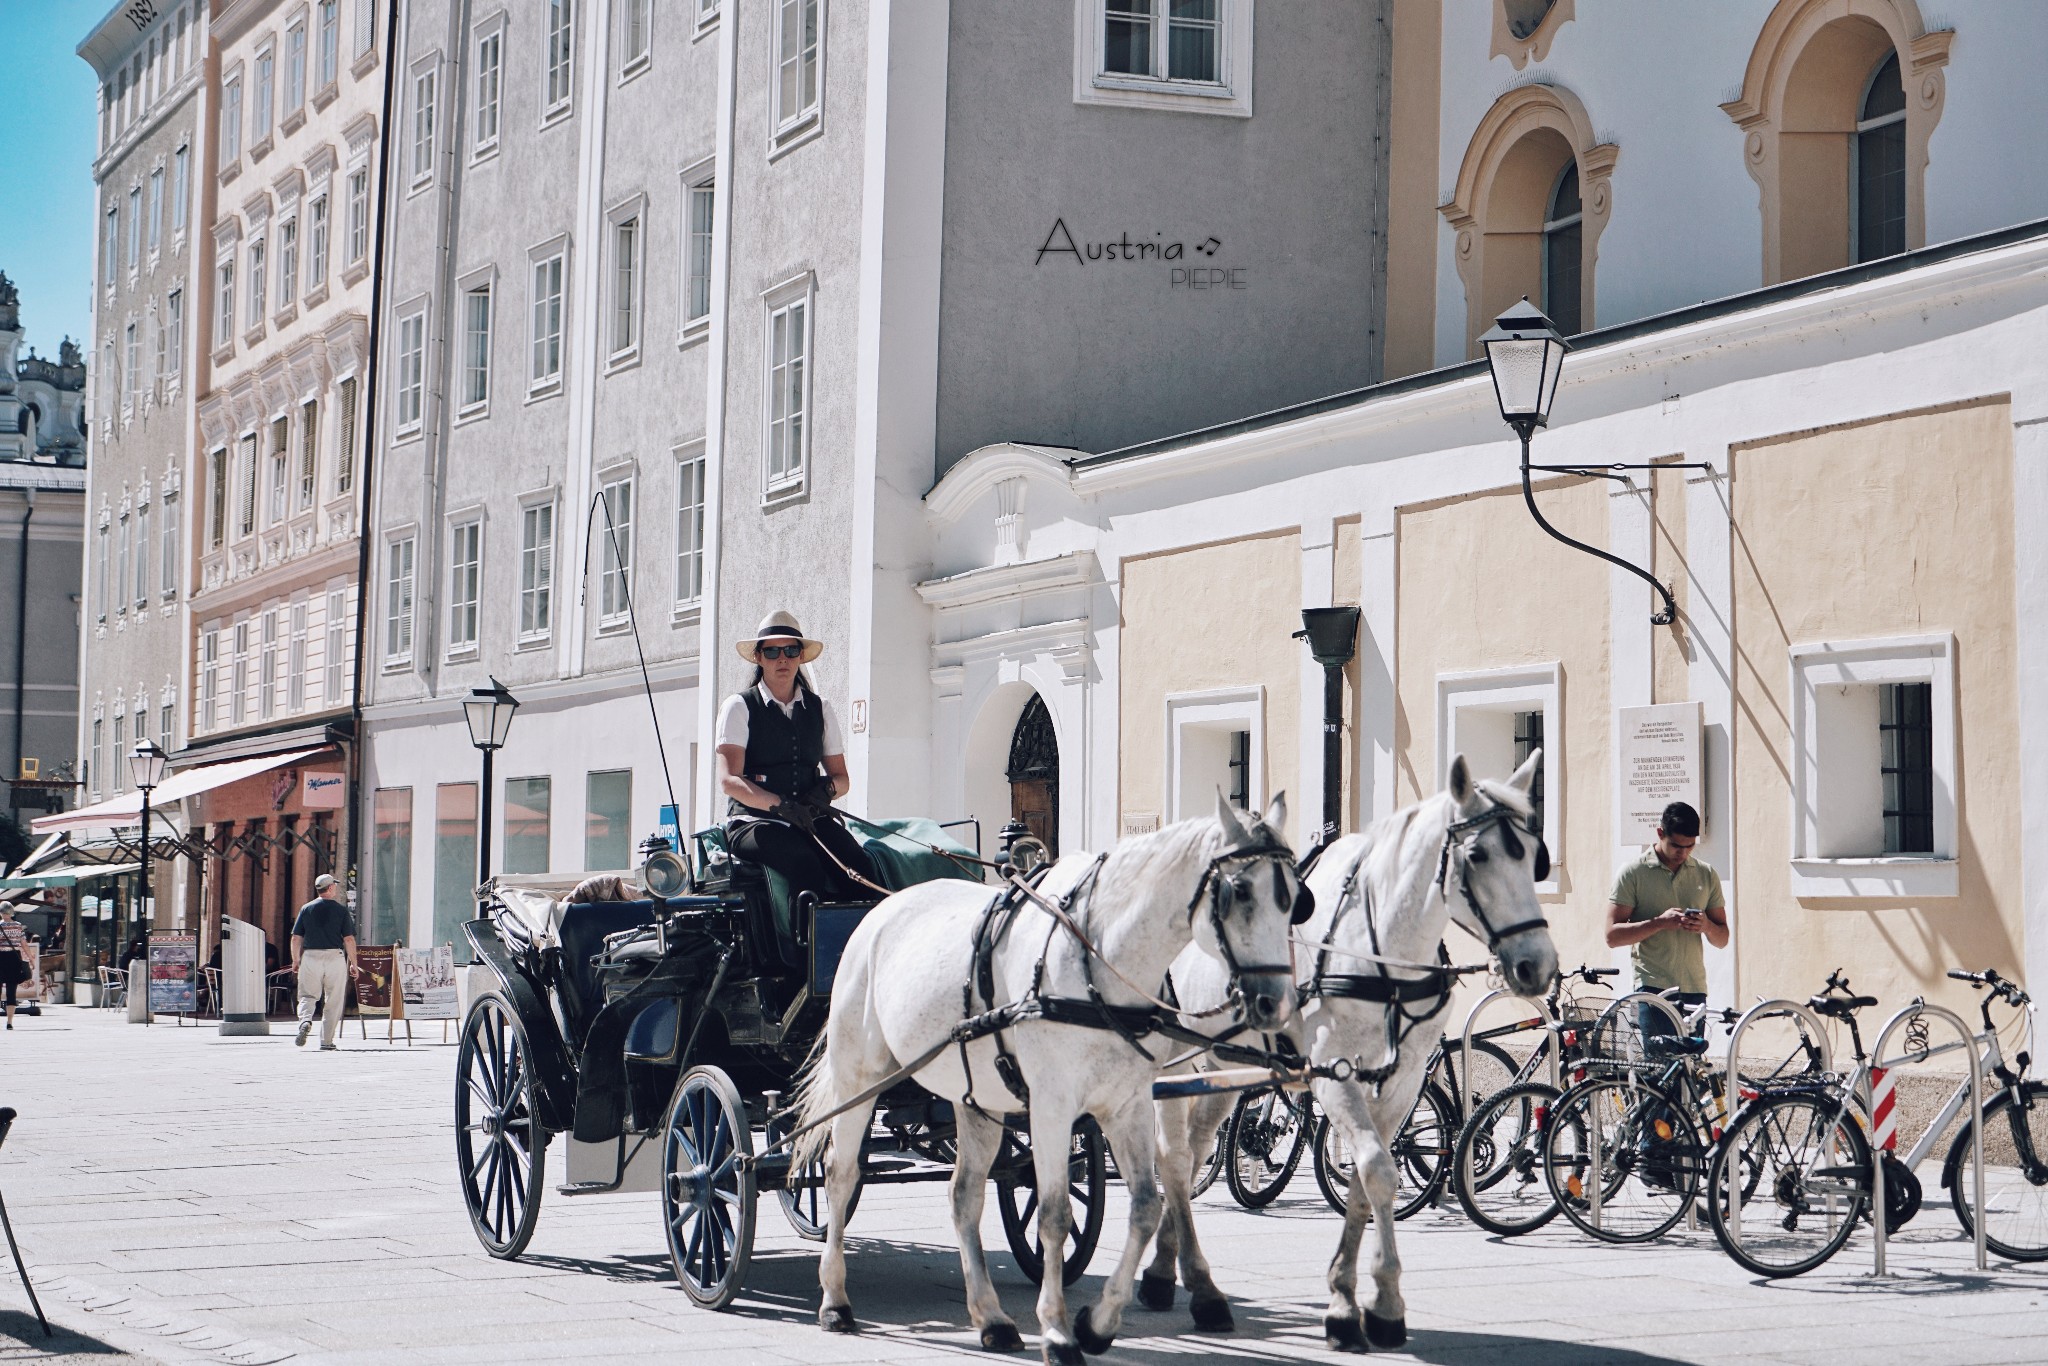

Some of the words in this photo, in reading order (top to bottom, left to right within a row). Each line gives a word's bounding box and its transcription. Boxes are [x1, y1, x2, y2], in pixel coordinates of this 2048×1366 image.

[1035, 217, 1184, 266] Austria
[1171, 268, 1247, 290] PIEPIE
[307, 777, 343, 790] Manner
[660, 823, 676, 838] HYPO
[404, 958, 445, 975] Dolce
[424, 974, 454, 989] Vita
